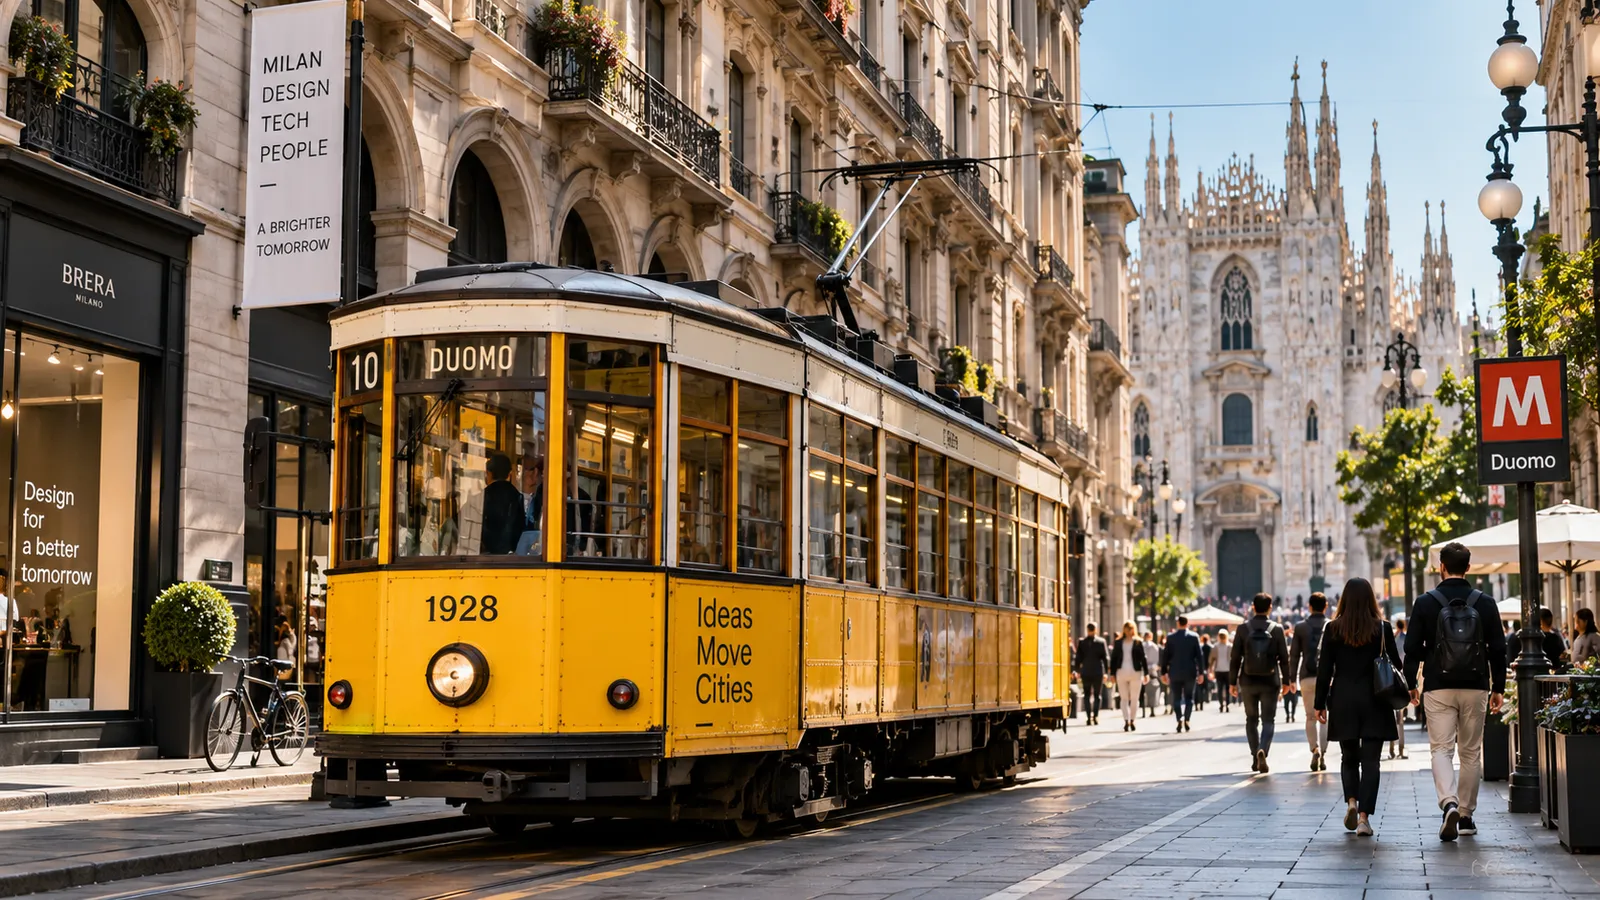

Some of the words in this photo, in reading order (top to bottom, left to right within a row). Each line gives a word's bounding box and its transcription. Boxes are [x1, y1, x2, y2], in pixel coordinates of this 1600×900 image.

[263, 51, 322, 74] MILAN
[262, 79, 330, 104] DESIGN
[261, 111, 309, 133] TECH
[260, 139, 328, 163] PEOPLE
[257, 222, 266, 236] A
[270, 215, 331, 234] BRIGHTER
[256, 238, 331, 257] TOMORROW
[62, 263, 116, 299] BRERA
[75, 294, 103, 309] MILANO
[351, 351, 378, 391] 10
[430, 345, 513, 373] DUOMO
[1492, 375, 1552, 427] M
[1491, 453, 1556, 471] Duomo
[24, 480, 75, 510] Design
[23, 507, 45, 529] for
[22, 540, 32, 555] a
[36, 536, 80, 559] better
[21, 563, 93, 586] tomorrow
[425, 594, 499, 622] 1928
[697, 597, 753, 630] Ideas
[697, 636, 752, 666] Move
[696, 673, 753, 705] Cities
